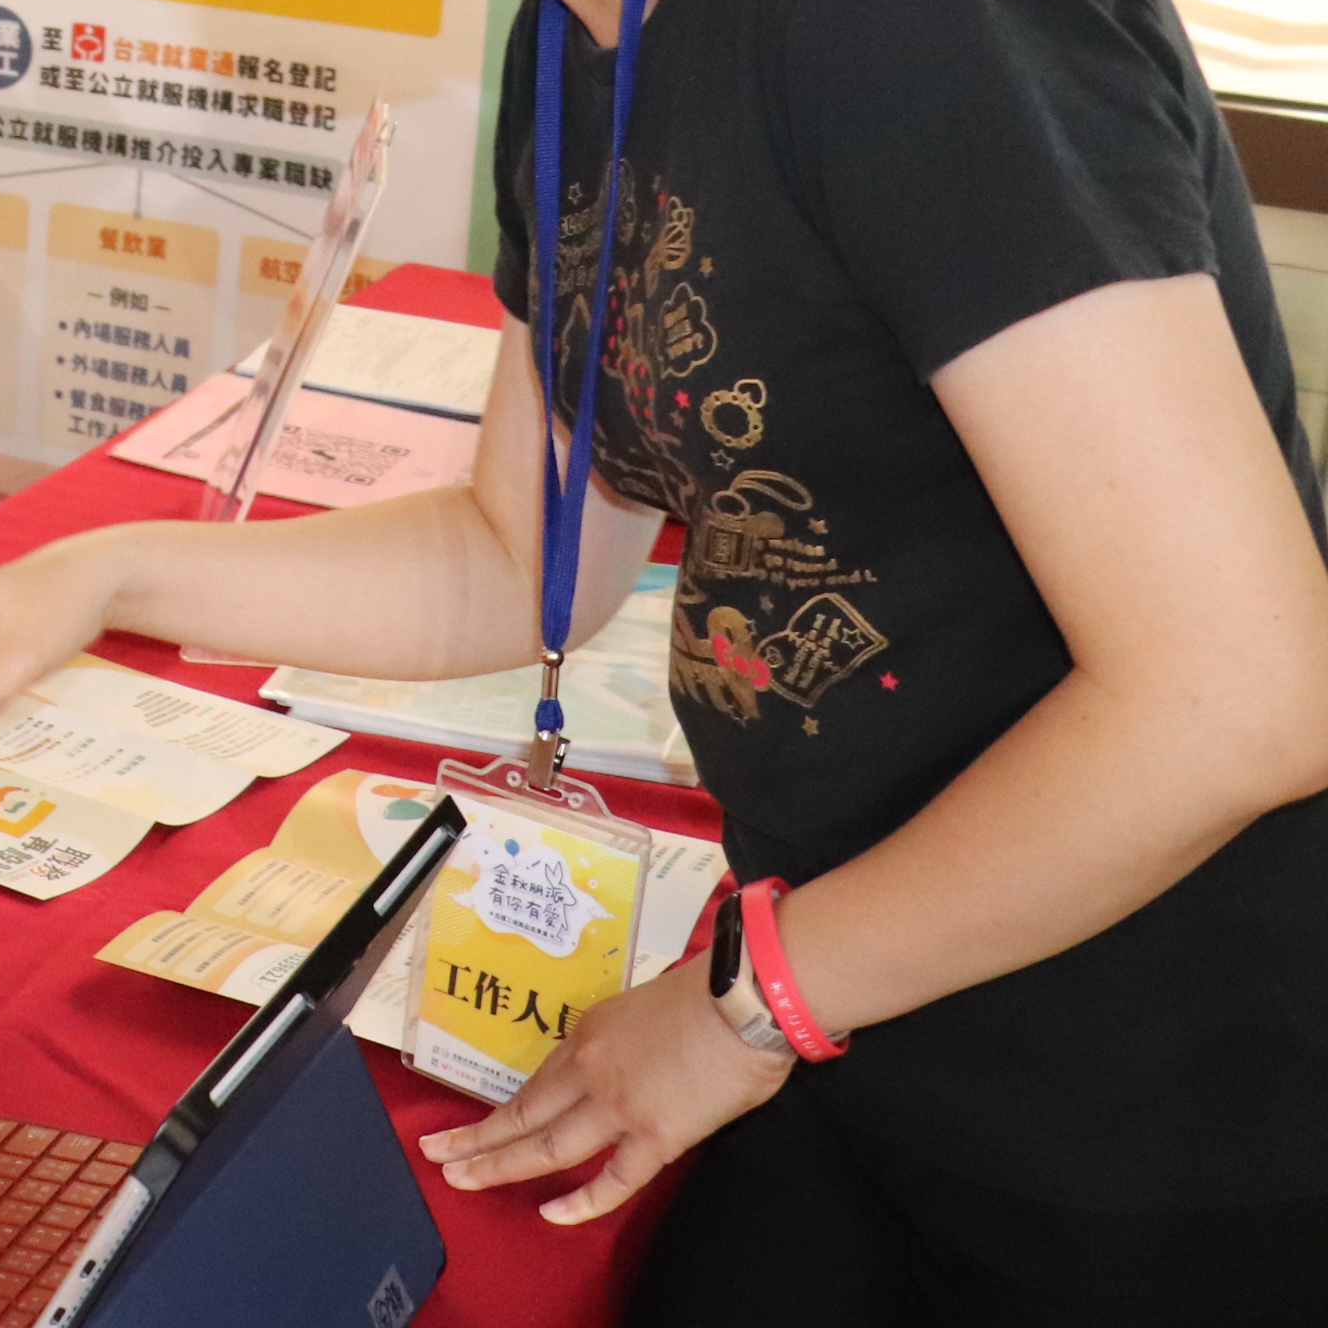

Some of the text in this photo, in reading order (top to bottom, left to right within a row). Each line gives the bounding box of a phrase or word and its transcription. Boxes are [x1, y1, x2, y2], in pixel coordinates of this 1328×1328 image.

[42, 26, 63, 52] 至
[40, 66, 337, 132] 或至公立就服機構求職登記
[99, 226, 168, 260] 餐飲業
[494, 863, 565, 904] 金秋朋派
[489, 887, 562, 930] 有你有愛
